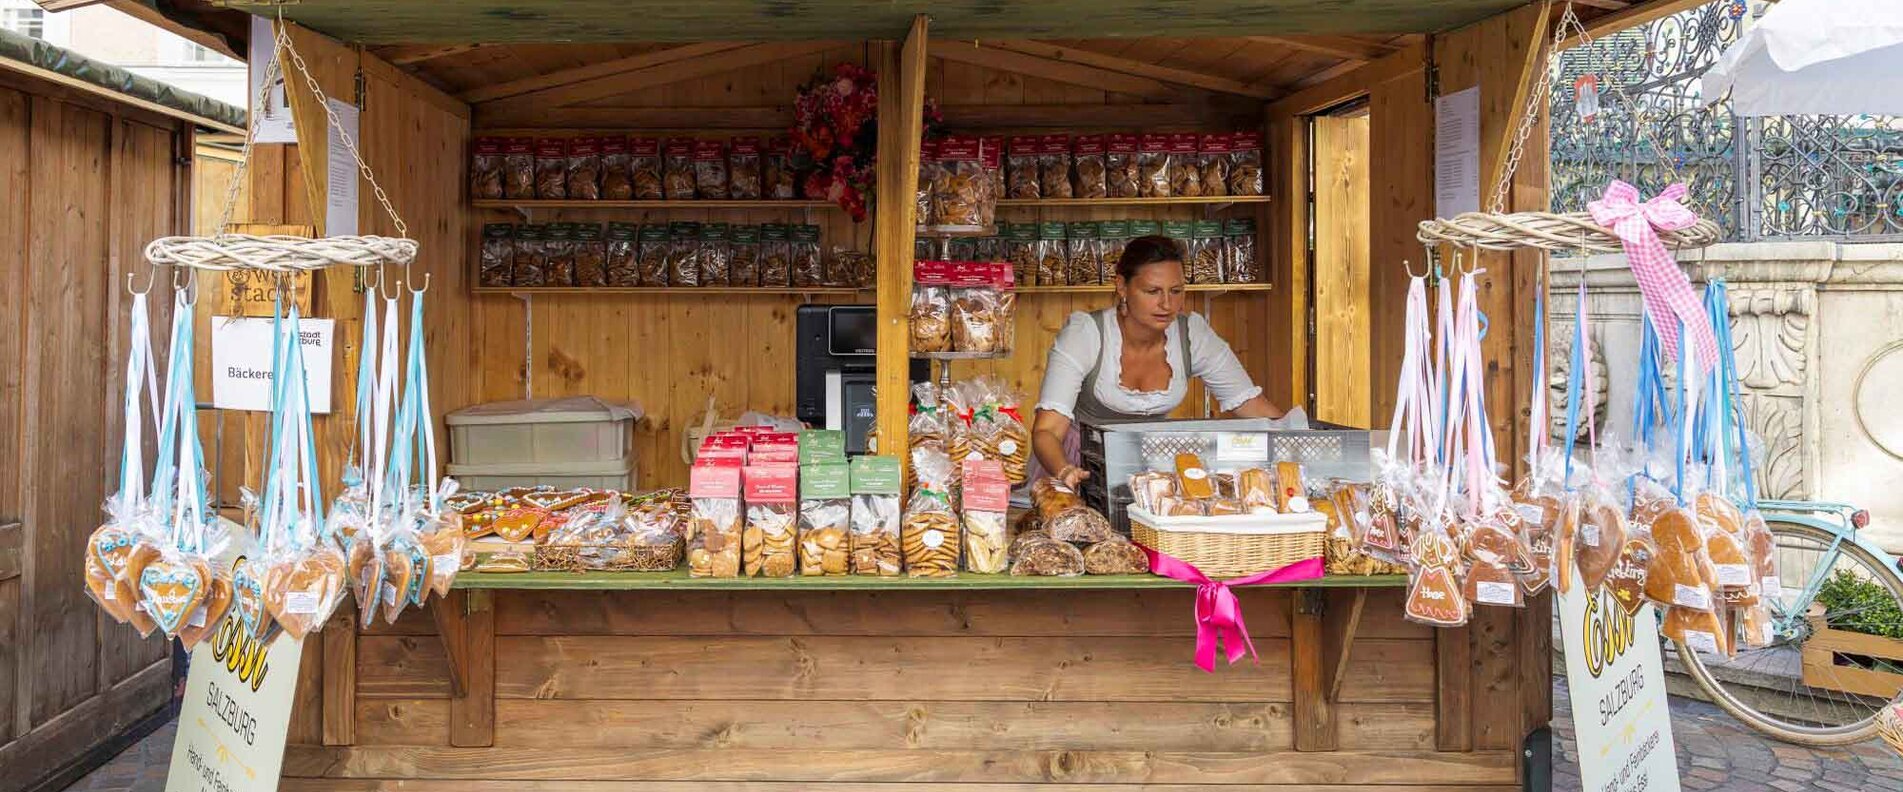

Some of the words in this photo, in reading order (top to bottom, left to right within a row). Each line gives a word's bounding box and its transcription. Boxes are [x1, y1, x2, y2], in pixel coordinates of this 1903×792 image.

[228, 366, 274, 380] Bäckere
[206, 682, 257, 746] SALZBURG
[1599, 664, 1645, 726] SALZBURG
